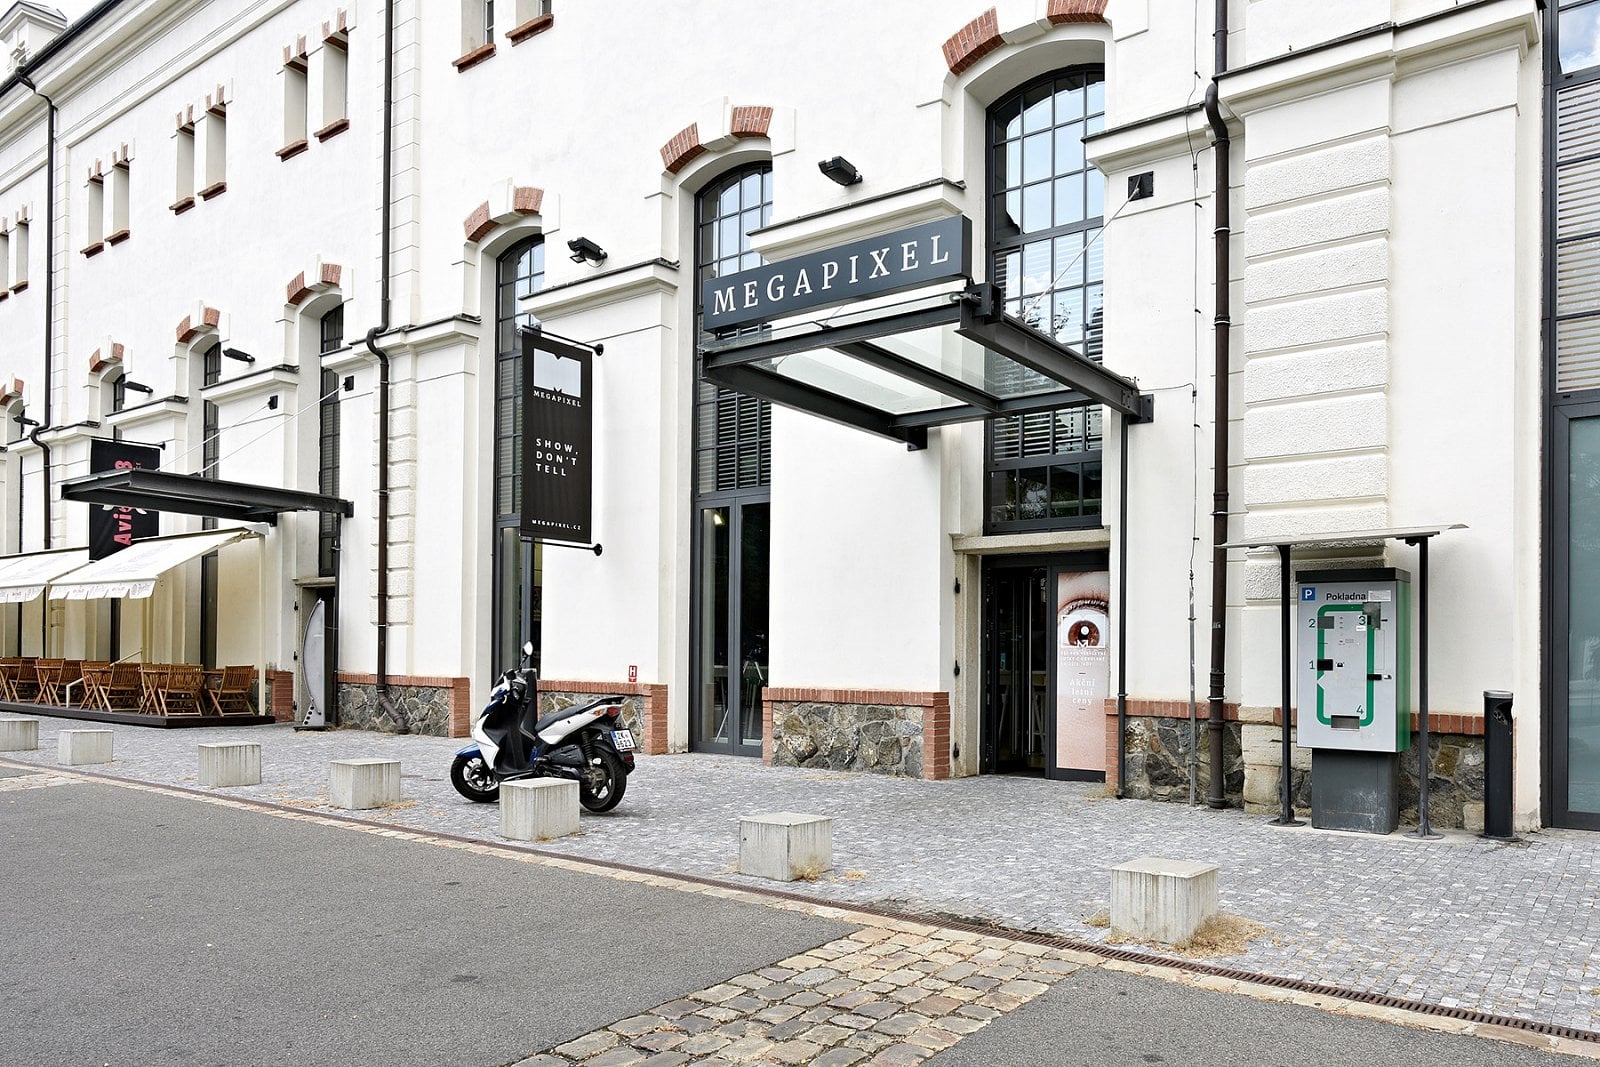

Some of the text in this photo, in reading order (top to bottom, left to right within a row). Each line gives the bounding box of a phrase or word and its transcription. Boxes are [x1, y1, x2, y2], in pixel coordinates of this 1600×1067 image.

[713, 235, 949, 316] MEGAPIXEL
[533, 389, 582, 408] MEGAPIXEL
[536, 438, 579, 456] SHOW,
[536, 450, 577, 466] DON'T
[536, 463, 567, 477] TELL
[532, 519, 581, 531] MEGAPIXEL.CZ
[1305, 589, 1313, 599] P
[1326, 592, 1366, 601] Pokladna
[1309, 619, 1316, 628] 2
[1359, 616, 1366, 626] 3
[1309, 660, 1315, 670] 1
[630, 666, 636, 677] H
[1072, 697, 1092, 706] ceny
[1356, 705, 1364, 715] 4
